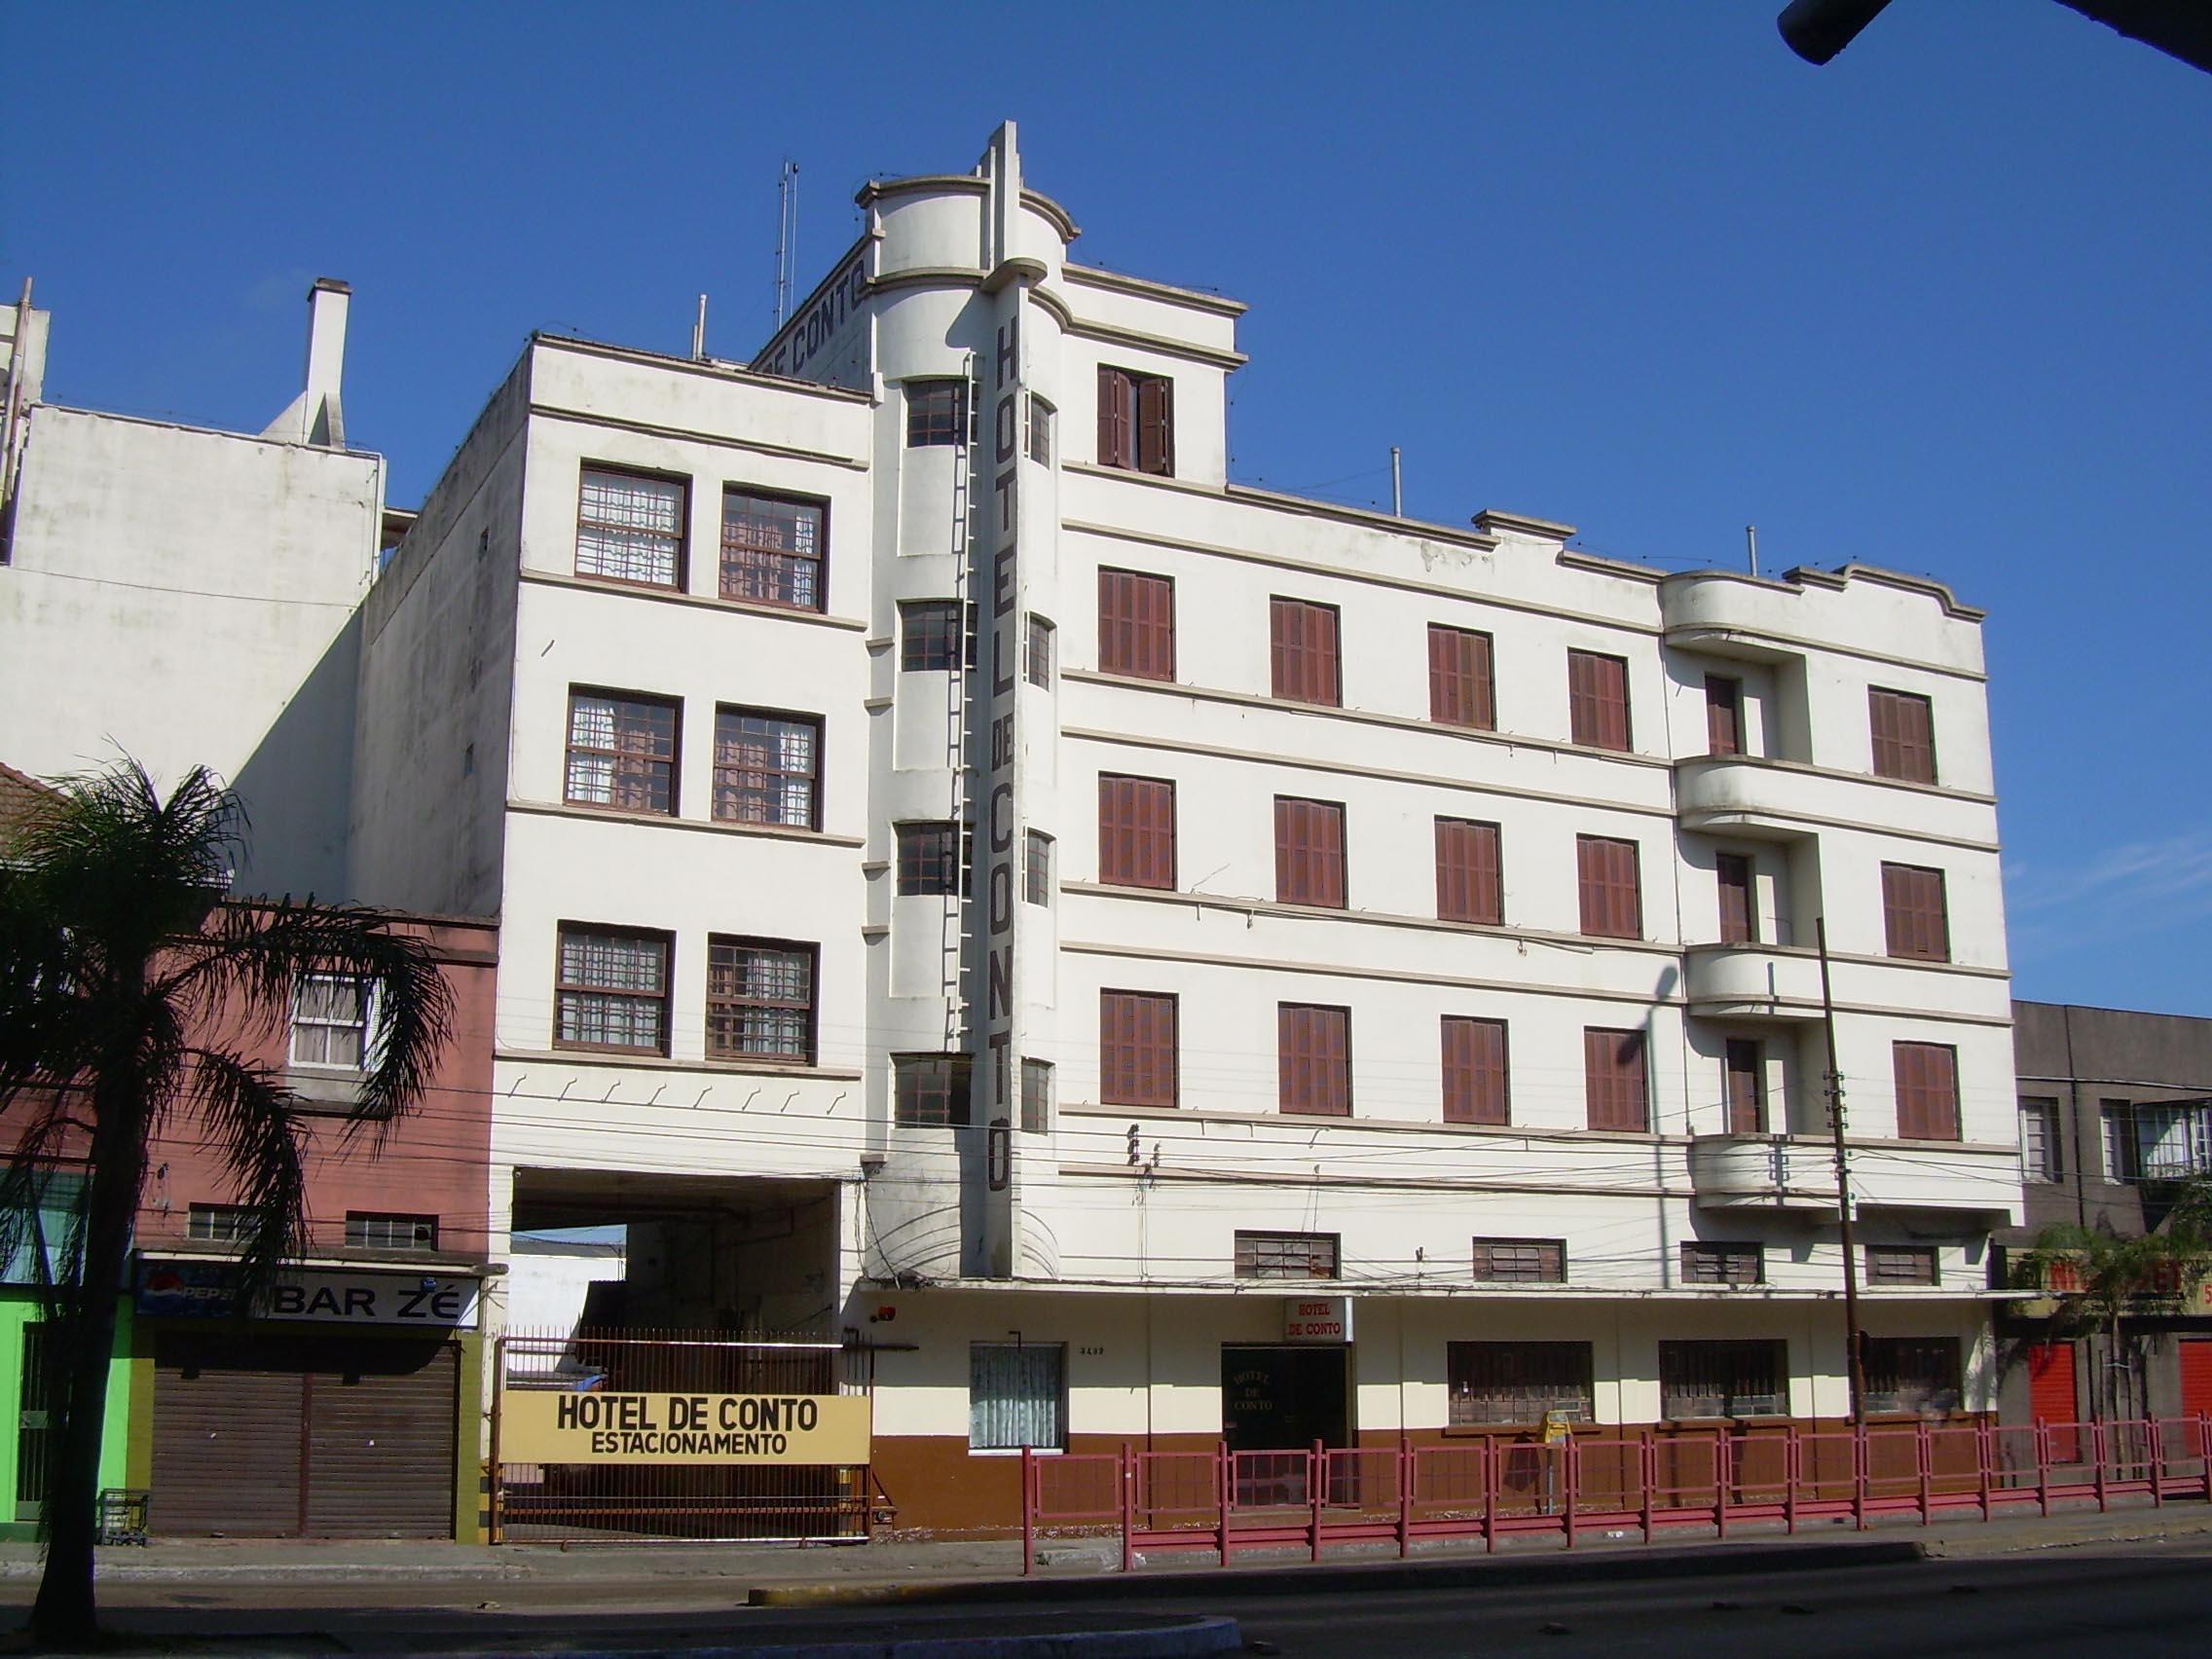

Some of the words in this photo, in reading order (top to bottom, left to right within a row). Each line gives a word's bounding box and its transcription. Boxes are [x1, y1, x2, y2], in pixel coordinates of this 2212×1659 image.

[793, 259, 866, 374] CONTO
[993, 314, 1017, 698] HOTEL
[991, 715, 1014, 772] DE
[988, 782, 1013, 1192] CONTO
[184, 1286, 237, 1301] PEPSI
[273, 1284, 376, 1316] BAR
[396, 1283, 461, 1319] ZÉ
[1299, 1304, 1331, 1316] HOTEL
[1289, 1323, 1303, 1336] DE
[1306, 1322, 1341, 1336] CONTO
[1233, 1370, 1271, 1386] HOTEL
[557, 1394, 657, 1429] HOTEL
[668, 1396, 709, 1430] DE
[719, 1397, 818, 1432] CONTO
[1234, 1401, 1273, 1411] CONTO
[591, 1431, 788, 1456] ESTACIONAMENTO
